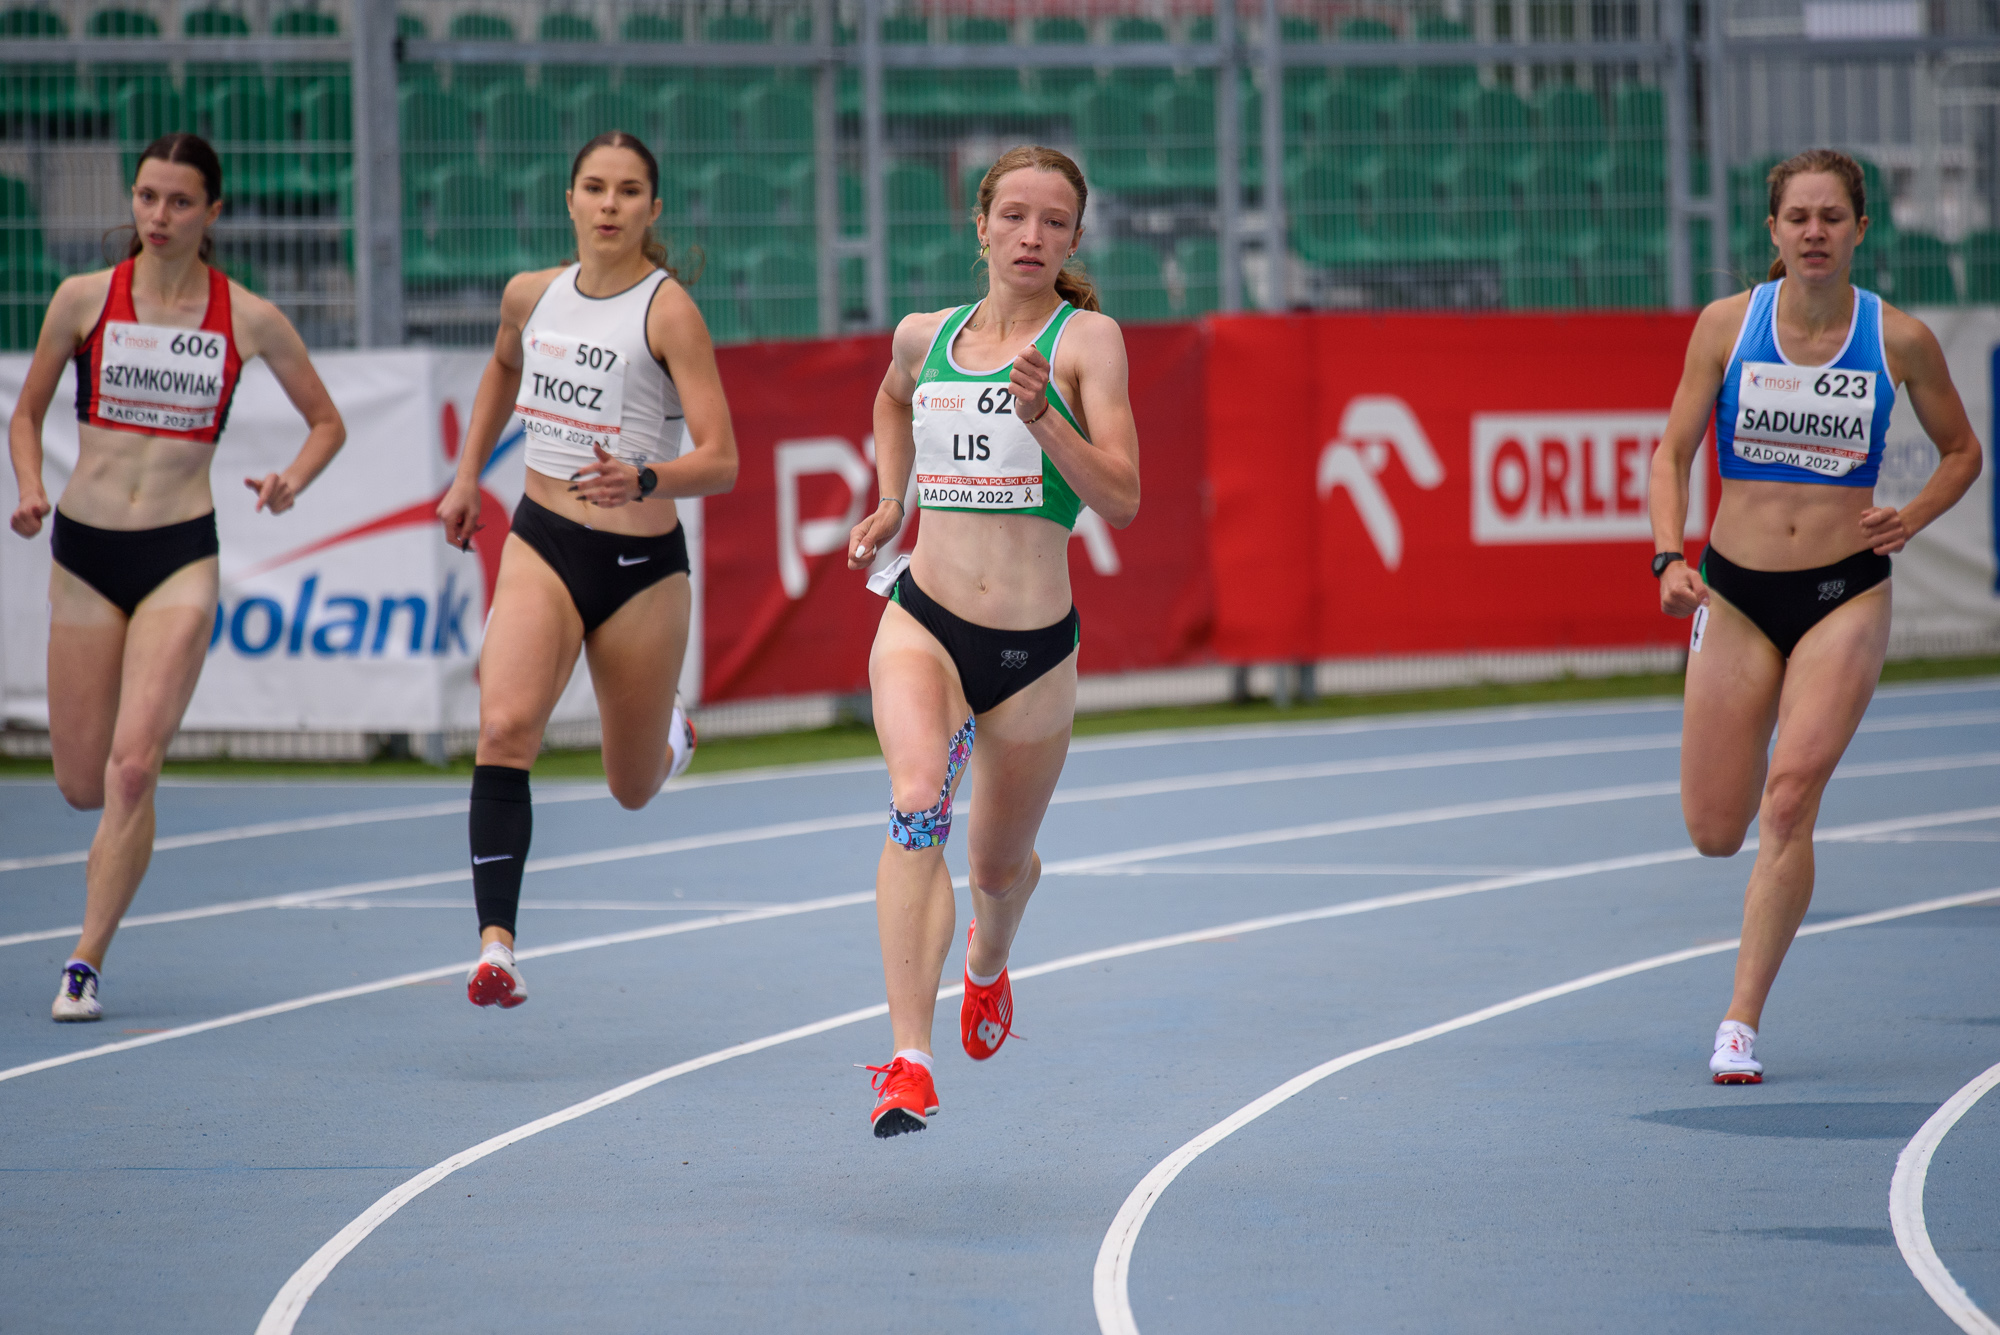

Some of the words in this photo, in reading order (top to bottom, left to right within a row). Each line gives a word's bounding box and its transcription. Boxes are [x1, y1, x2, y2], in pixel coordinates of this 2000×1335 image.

[125, 336, 158, 349] mosir
[170, 334, 218, 358] 606
[575, 343, 618, 372] 507
[105, 365, 218, 397] SZYMKOWIAK
[532, 372, 603, 411] TKOCZ
[1764, 376, 1802, 391] mosir
[1814, 373, 1868, 399] 623
[930, 394, 966, 409] mosir
[977, 387, 1017, 414] 62
[107, 406, 158, 424] RADOM
[163, 415, 195, 428] 2022
[1742, 408, 1865, 440] SADURSKA
[520, 418, 562, 439] RADOM
[565, 430, 593, 447] 2022
[953, 434, 991, 461] LIS
[1743, 446, 1800, 466] RADOM
[1804, 456, 1840, 472] 2022
[919, 475, 936, 484] PZLA
[936, 476, 988, 486] MISTRZOSTWA
[989, 478, 1019, 486] POLSKI
[1020, 476, 1039, 484] U20
[1491, 437, 1660, 517] ORLE
[923, 488, 973, 502] RADOM
[977, 491, 1014, 503] 2022
